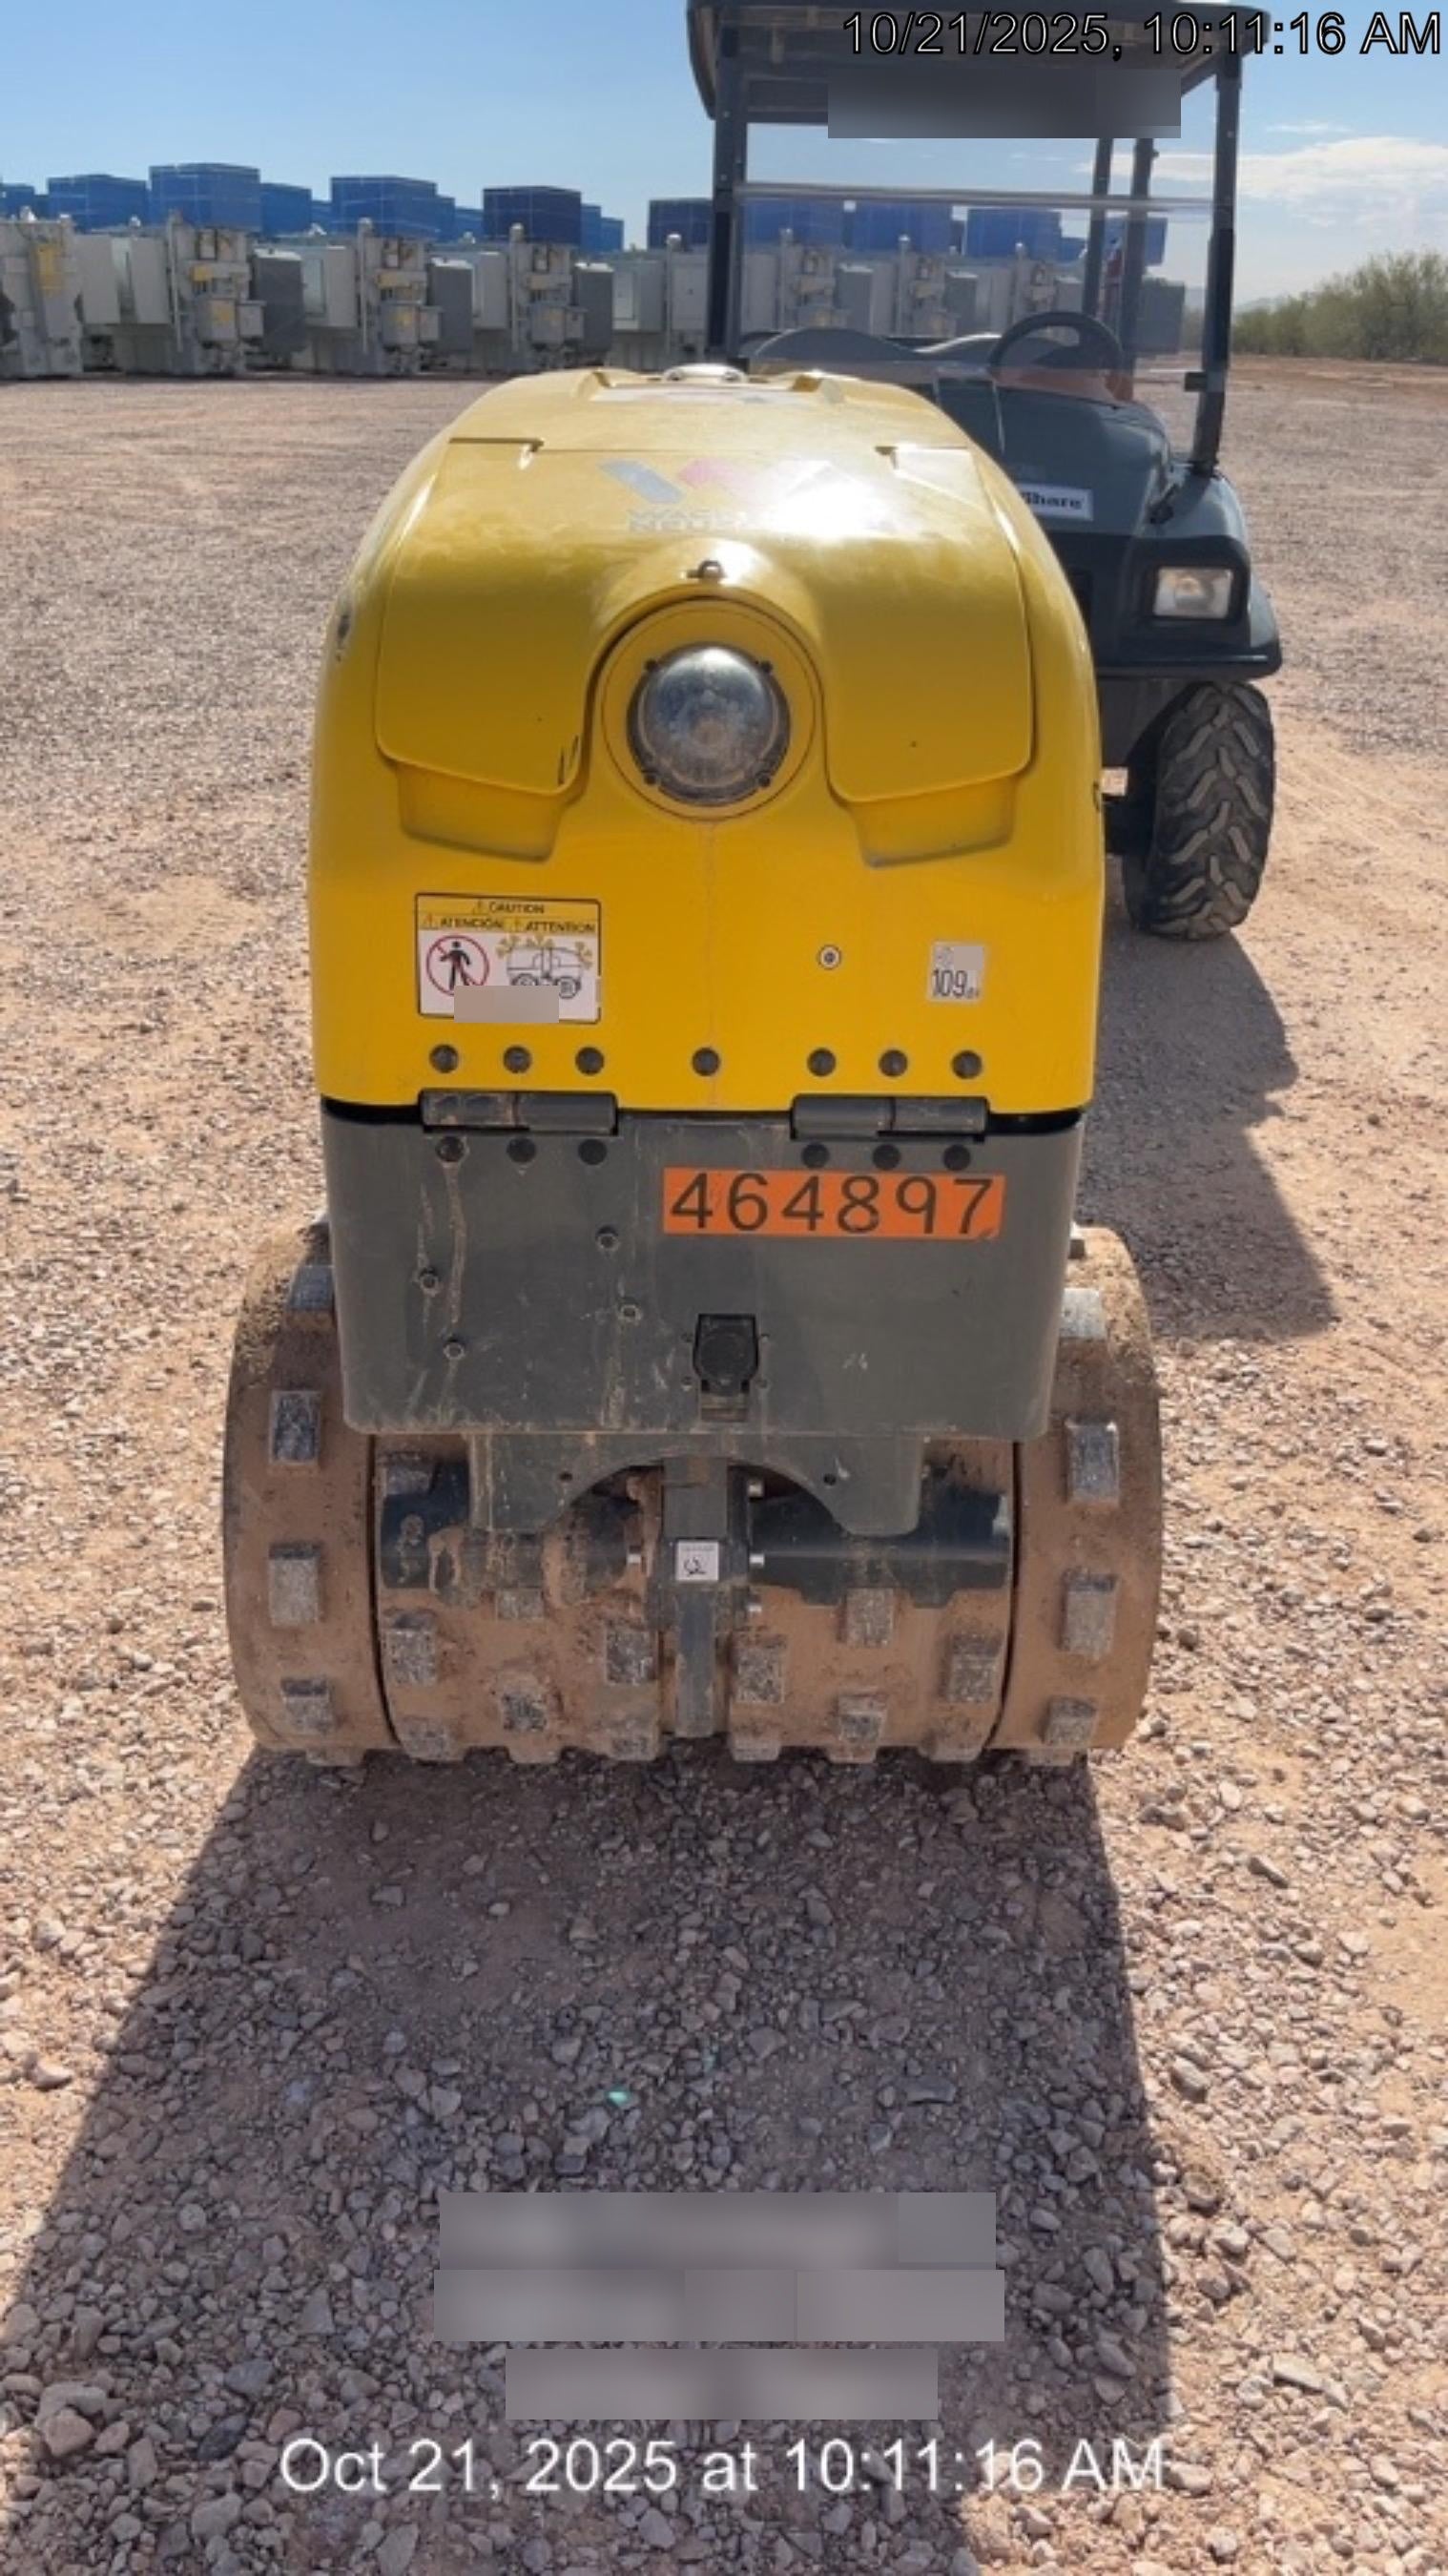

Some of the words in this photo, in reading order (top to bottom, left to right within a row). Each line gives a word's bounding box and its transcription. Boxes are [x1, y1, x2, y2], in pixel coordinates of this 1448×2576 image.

[488, 901, 545, 915] CAUTION
[524, 920, 595, 933] ATTENTION
[933, 969, 967, 998] 109
[671, 1172, 993, 1235] 464897
